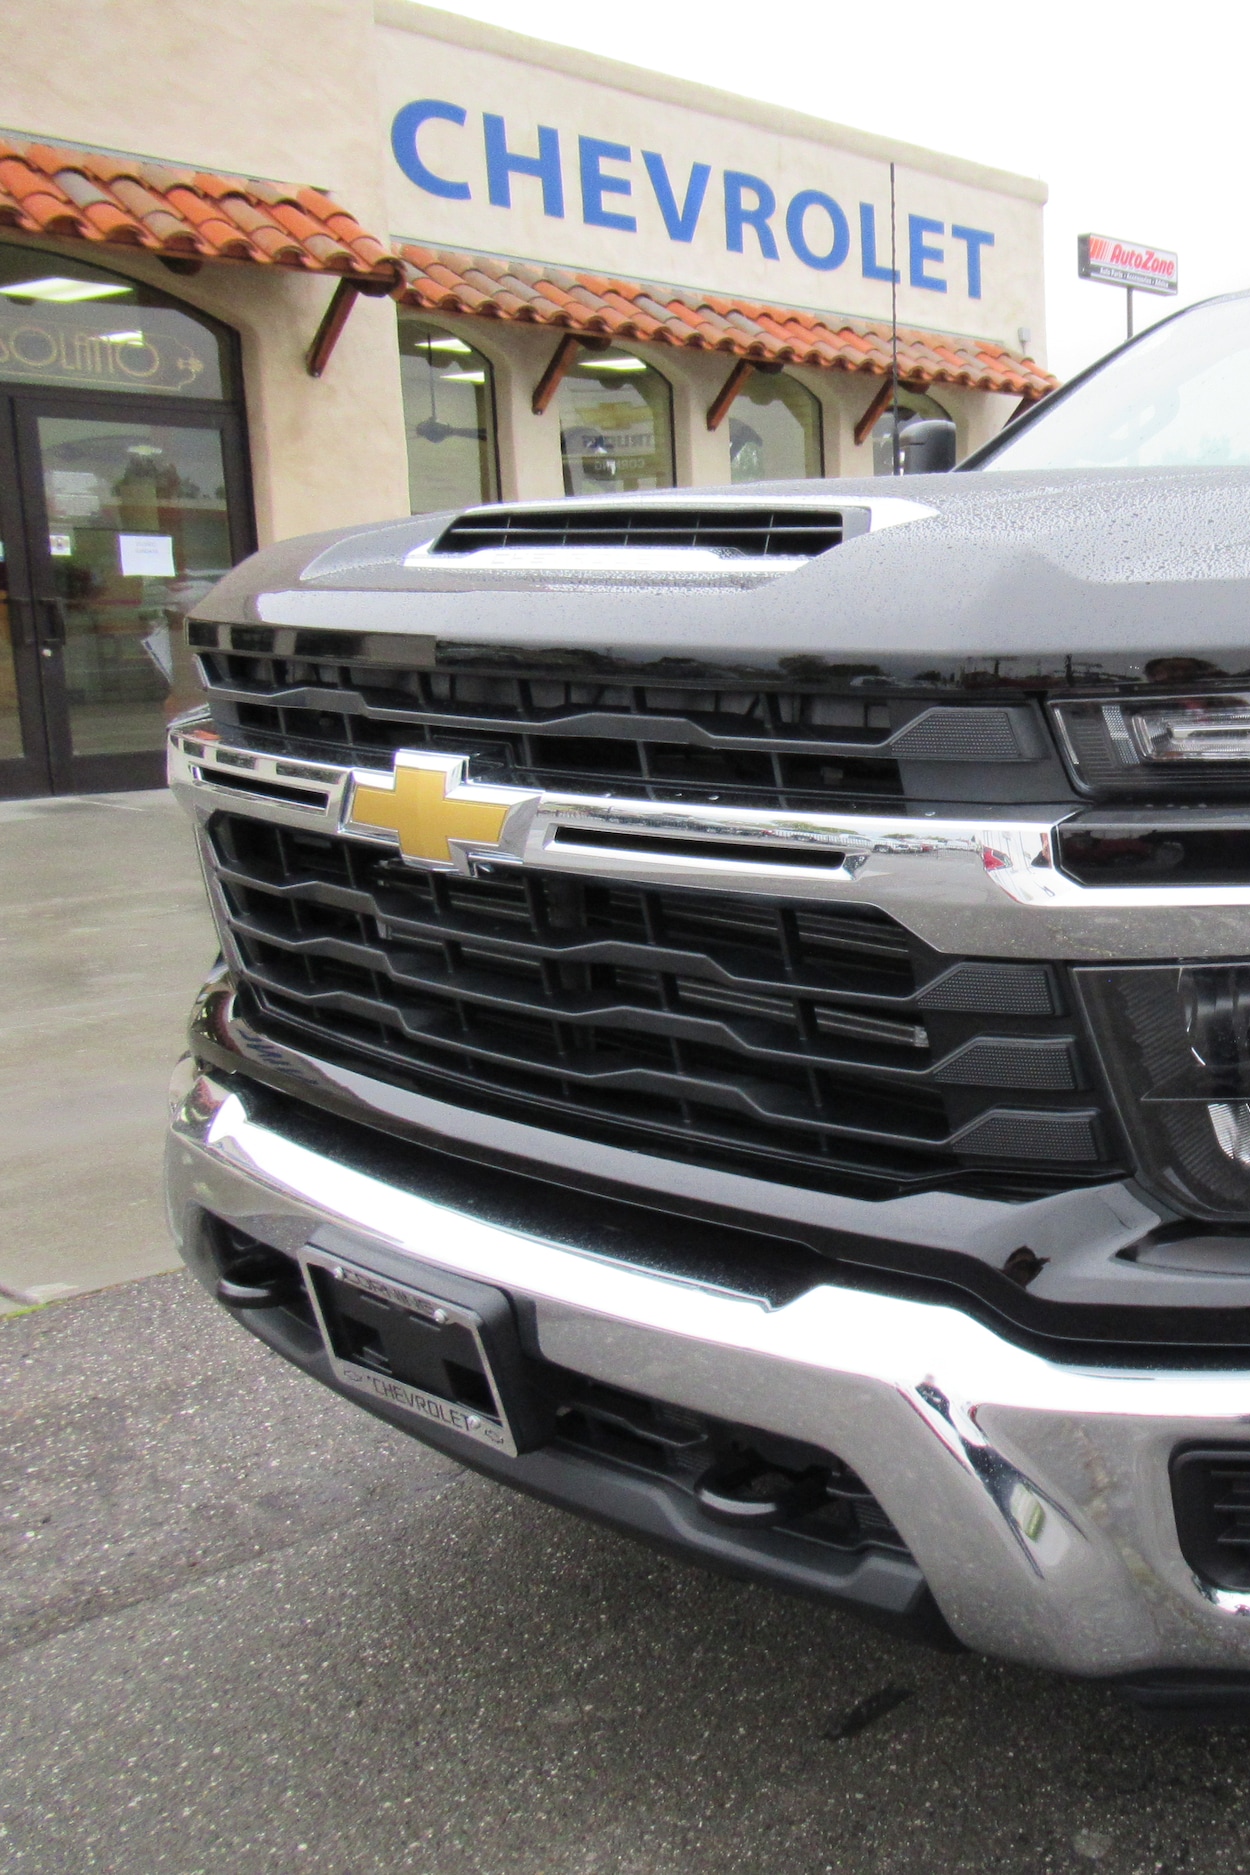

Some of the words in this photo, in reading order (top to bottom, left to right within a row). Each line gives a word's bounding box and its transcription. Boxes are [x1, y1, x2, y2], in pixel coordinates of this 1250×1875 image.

[390, 98, 995, 300] CHEVROLET
[1109, 243, 1176, 277] AutoZone
[373, 1377, 470, 1432] CHEVROLET
